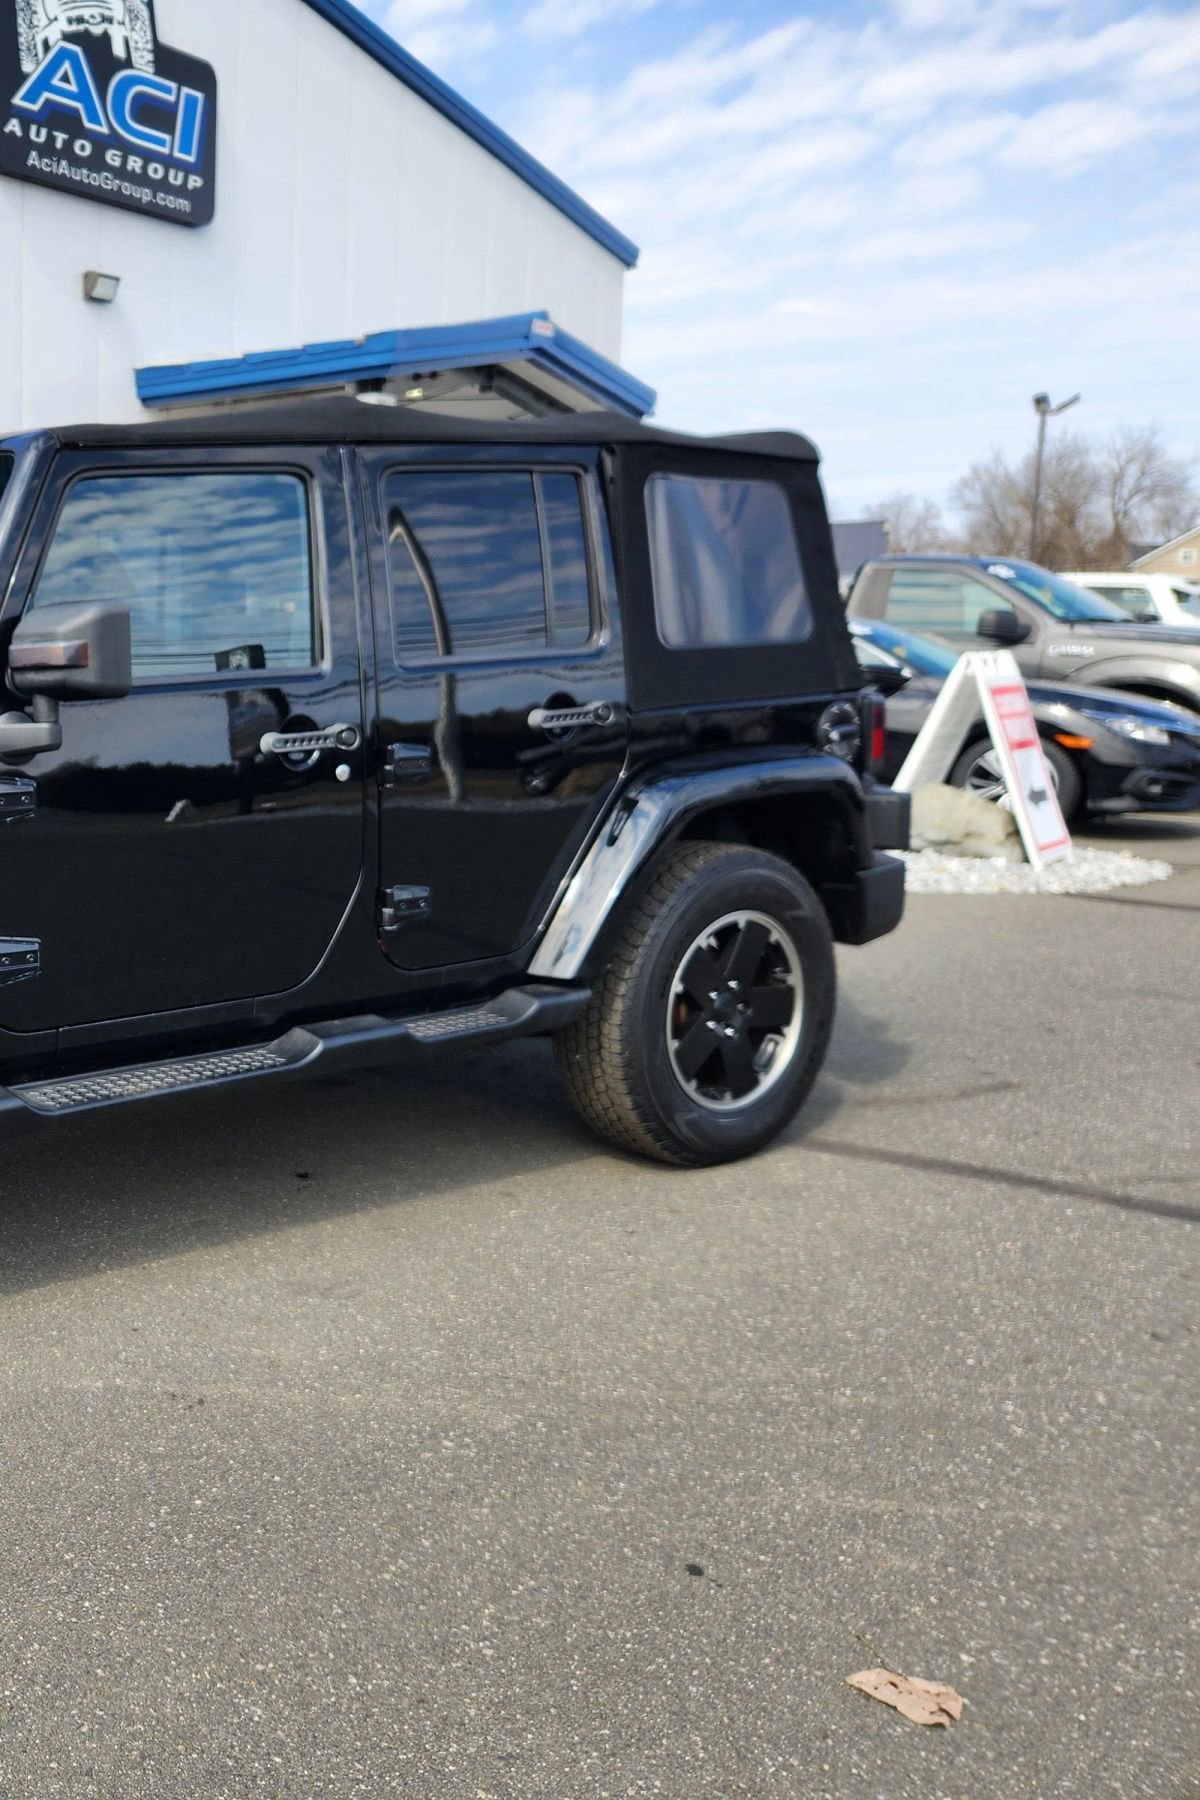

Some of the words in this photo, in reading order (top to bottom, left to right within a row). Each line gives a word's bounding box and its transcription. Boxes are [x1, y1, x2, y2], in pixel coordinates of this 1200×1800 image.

[11, 40, 205, 163] ACI
[3, 117, 93, 157] AUTO
[104, 149, 204, 191] GROUP
[26, 150, 192, 214] AciAutoGroup.com
